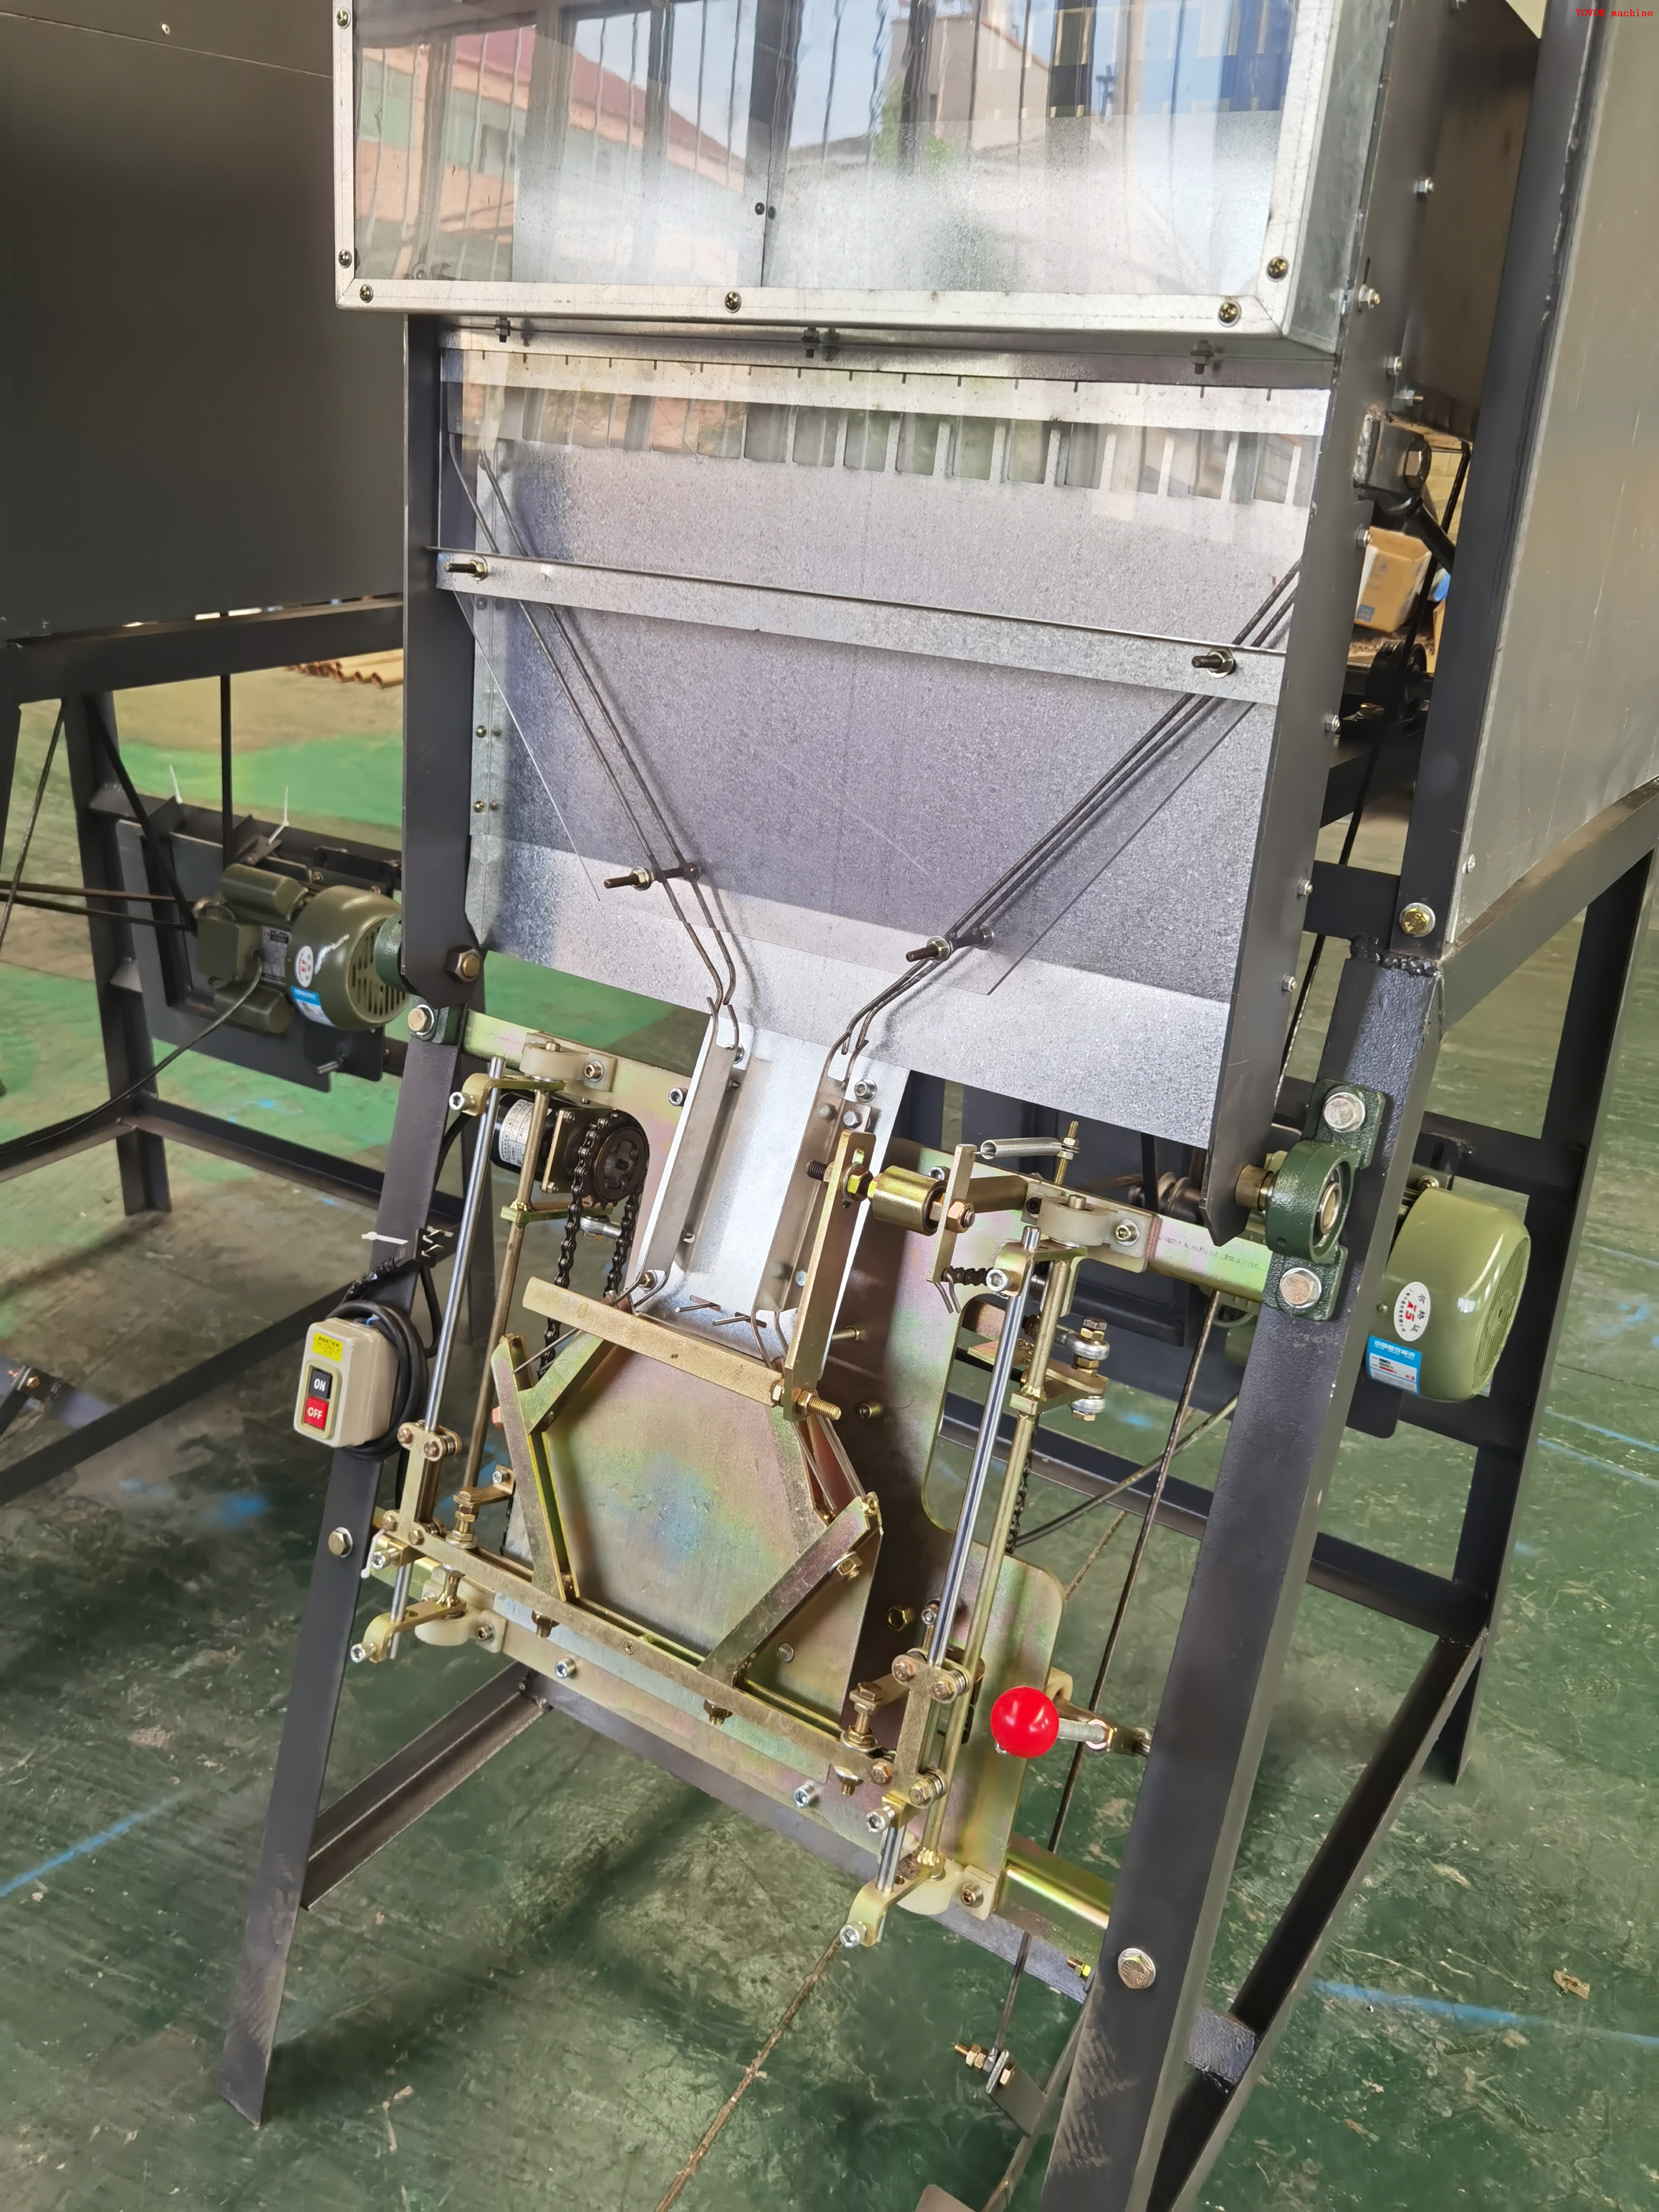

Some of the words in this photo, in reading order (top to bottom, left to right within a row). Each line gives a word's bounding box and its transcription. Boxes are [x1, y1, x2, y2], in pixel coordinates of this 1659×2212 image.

[1410, 1293, 1426, 1333] 合格证
[314, 1378, 326, 1392] ON
[308, 1407, 322, 1420] OFF
